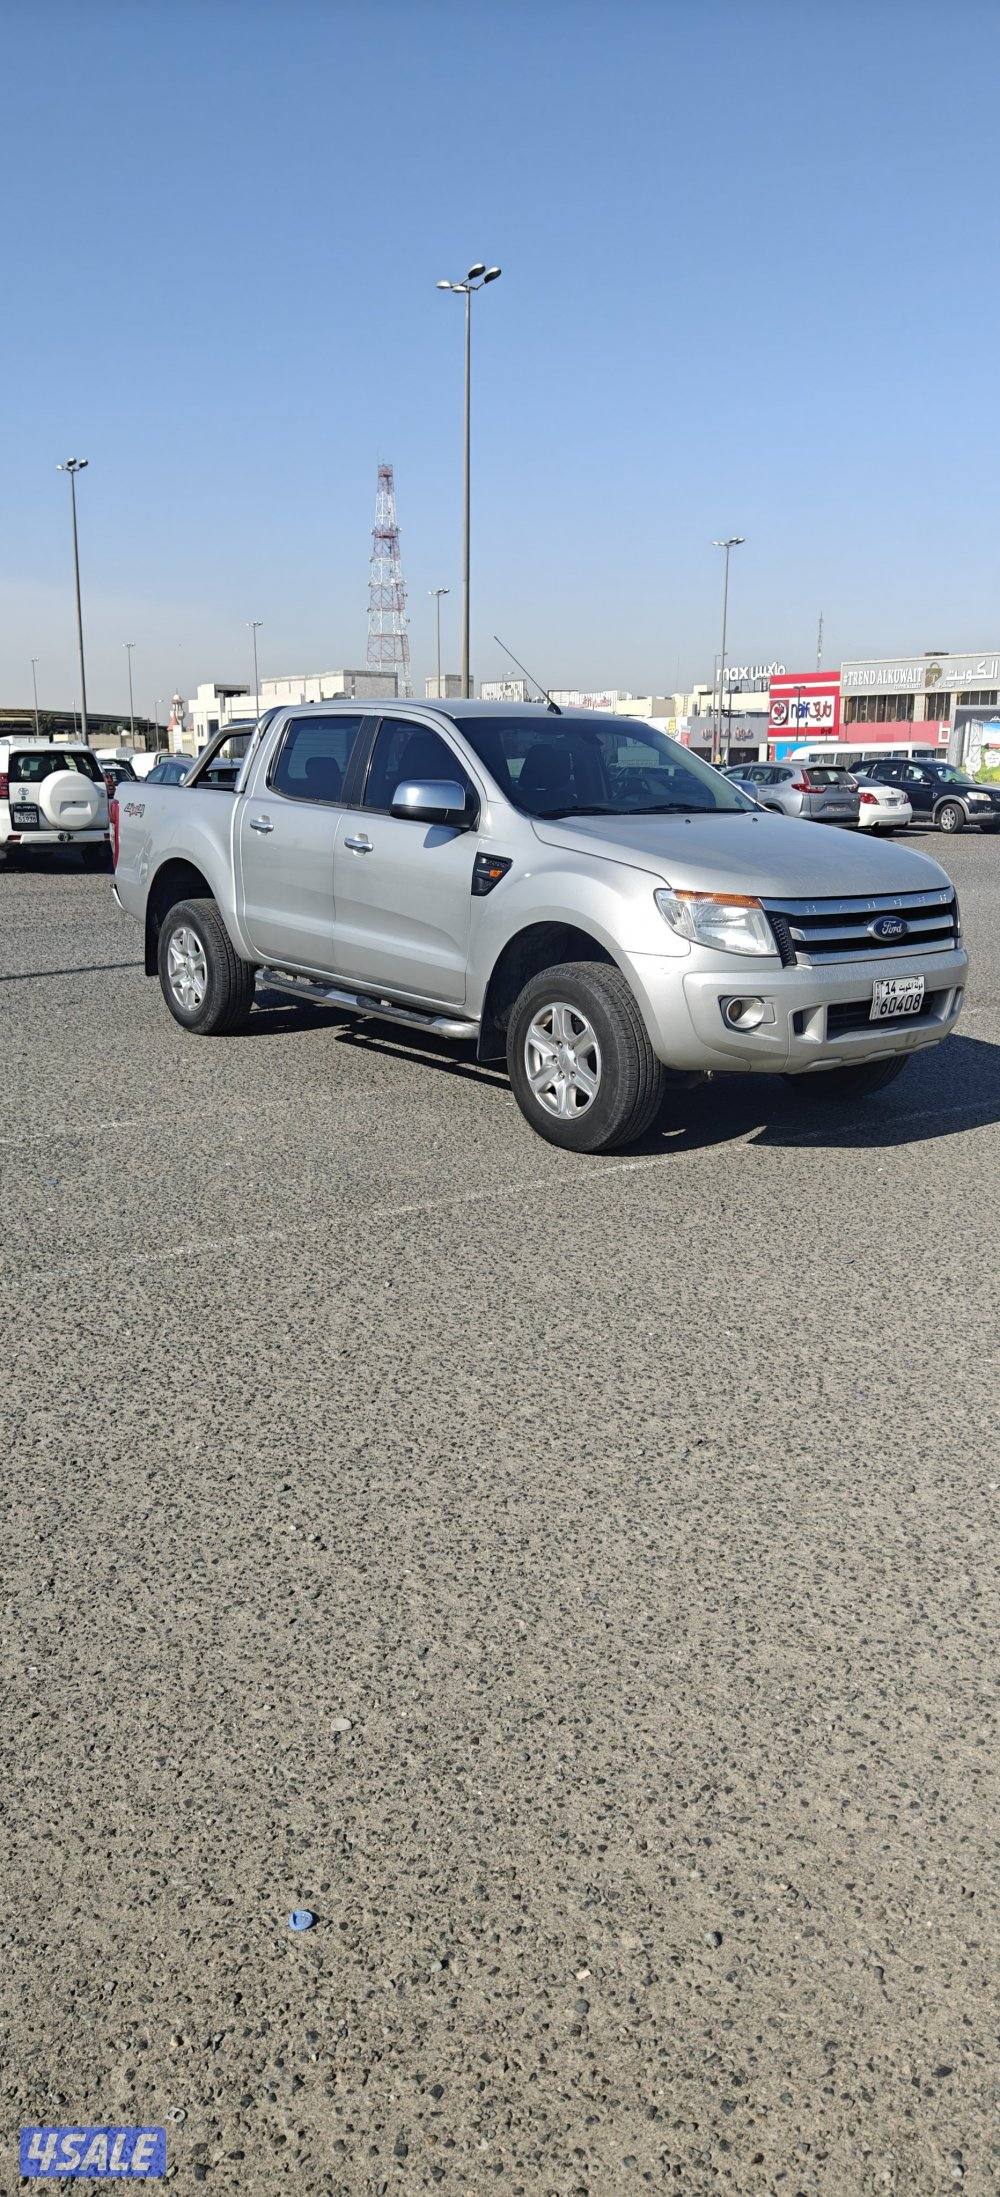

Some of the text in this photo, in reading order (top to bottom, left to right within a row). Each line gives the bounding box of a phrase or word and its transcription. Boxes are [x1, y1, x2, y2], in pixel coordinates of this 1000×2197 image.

[717, 666, 749, 681] max
[844, 667, 923, 686] #TREND ALKUWAIT
[881, 920, 903, 935] Ford
[885, 981, 896, 995] 14
[880, 993, 922, 1015] 60408
